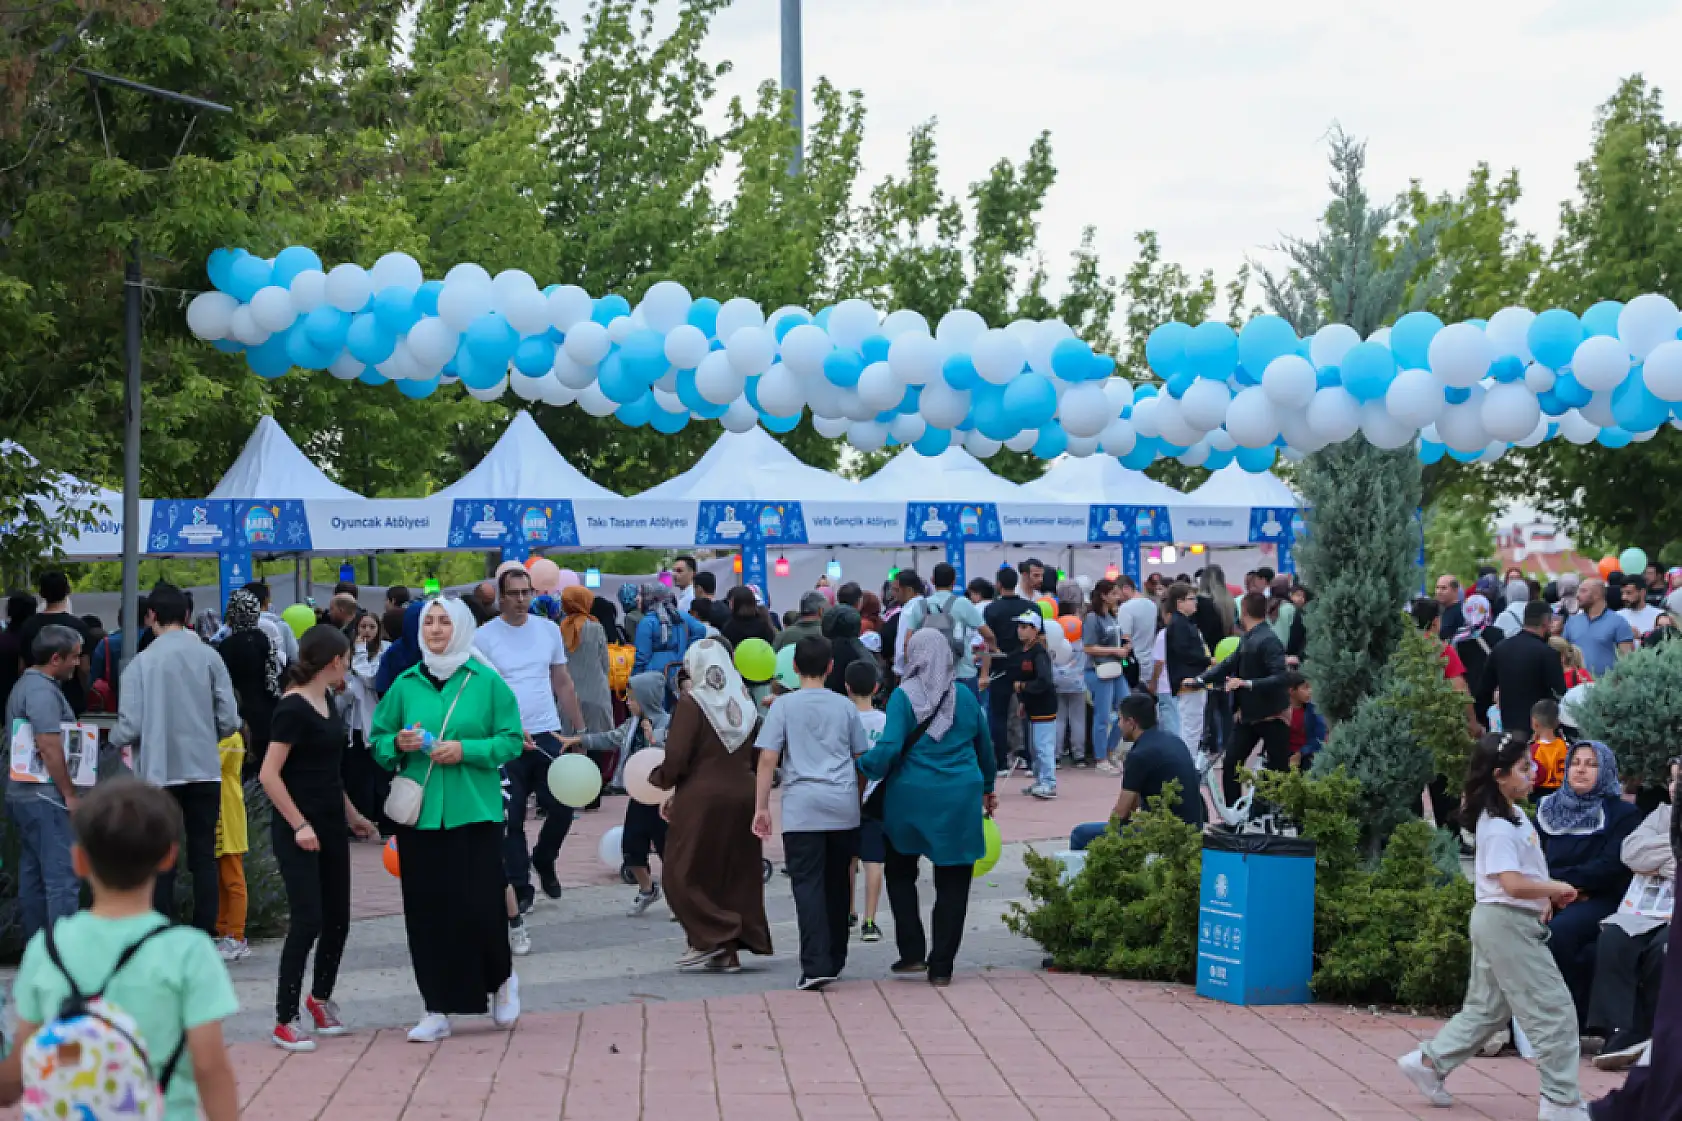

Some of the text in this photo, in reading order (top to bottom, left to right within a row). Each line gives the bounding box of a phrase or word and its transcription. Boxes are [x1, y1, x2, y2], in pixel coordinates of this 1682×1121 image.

[331, 515, 429, 531] Oyuncak Atölyesi
[610, 516, 647, 528] Tasarım
[649, 515, 688, 529] Atölyesi
